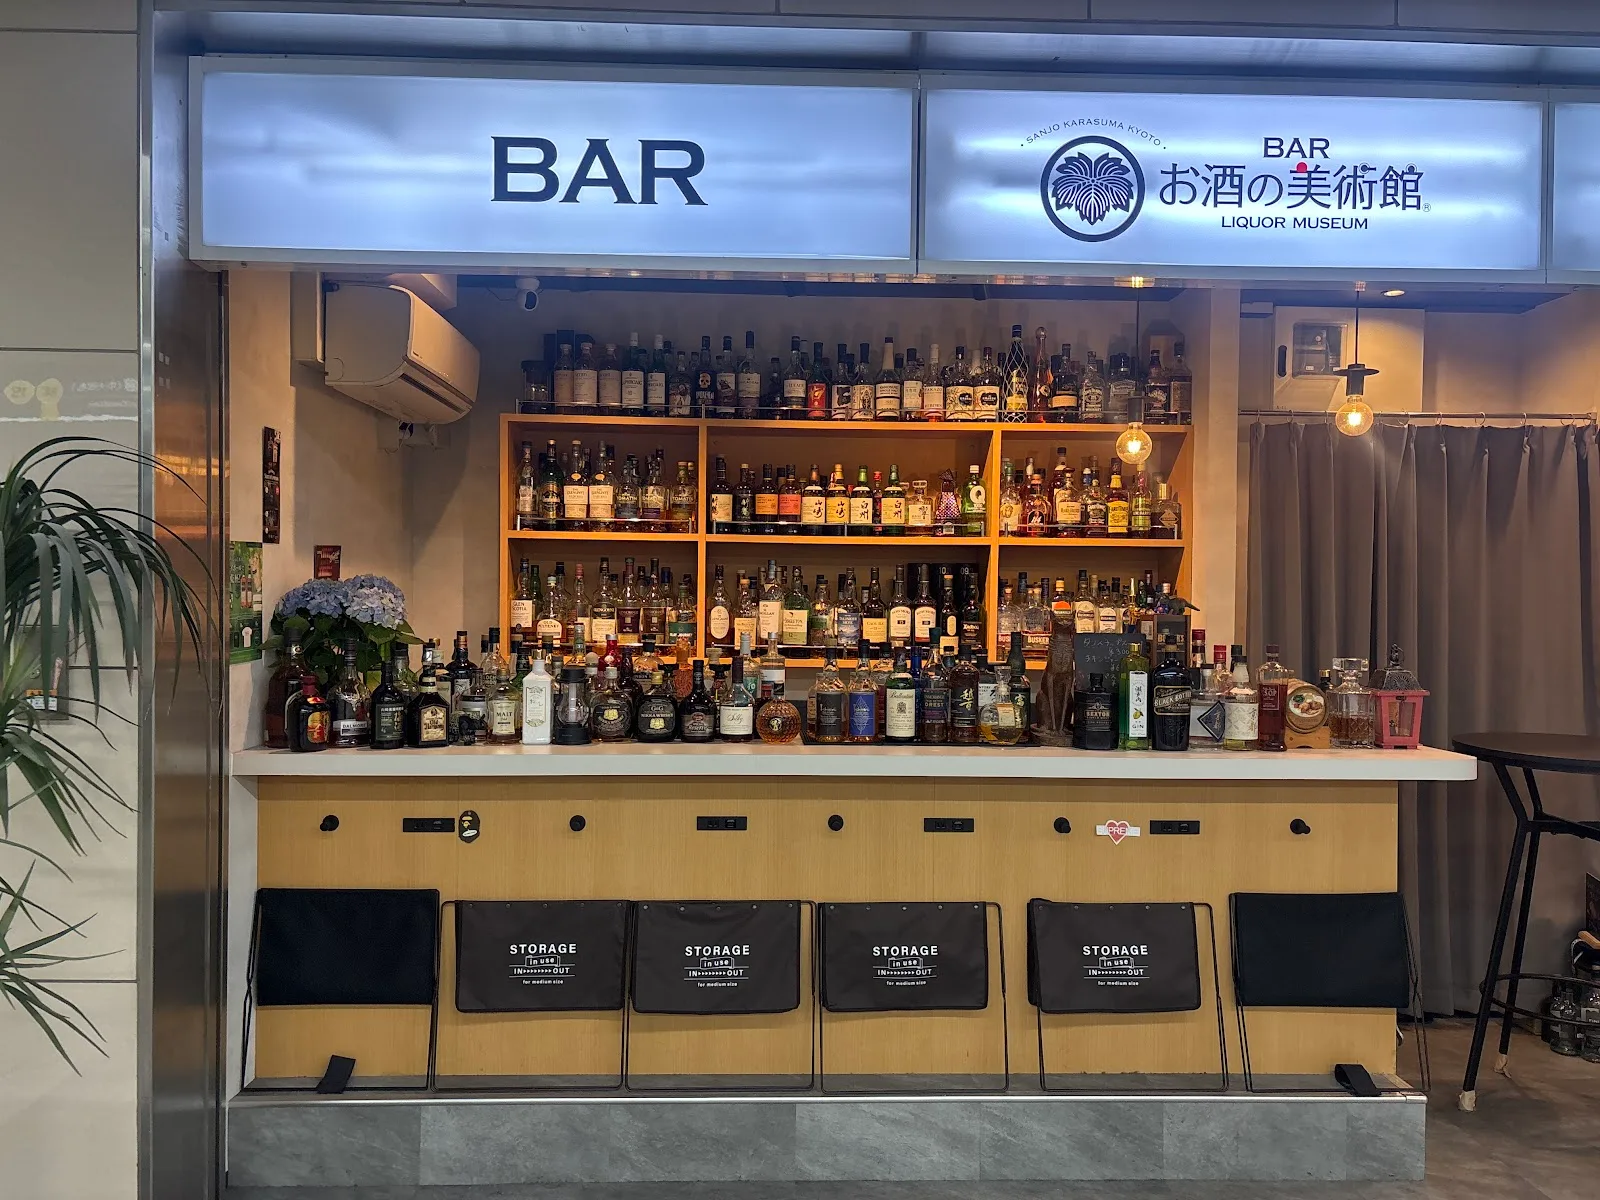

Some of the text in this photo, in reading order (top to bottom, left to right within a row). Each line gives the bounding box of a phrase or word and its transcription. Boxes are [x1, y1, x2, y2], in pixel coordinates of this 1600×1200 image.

[1026, 118, 1161, 146] SANJO KARASUMA KYOTO
[1263, 137, 1330, 159] BAR
[491, 136, 708, 205] BAR
[1159, 162, 1424, 210] お酒の美術館
[1221, 216, 1368, 230] LIQUOR MUSEUM
[1028, 636, 1050, 644] BUSKER
[1154, 697, 1174, 707] BLACK
[510, 944, 577, 954] STORAGE
[685, 945, 750, 956] STORAGE
[873, 946, 938, 956] STORAGE
[1083, 945, 1148, 956] STORAGE
